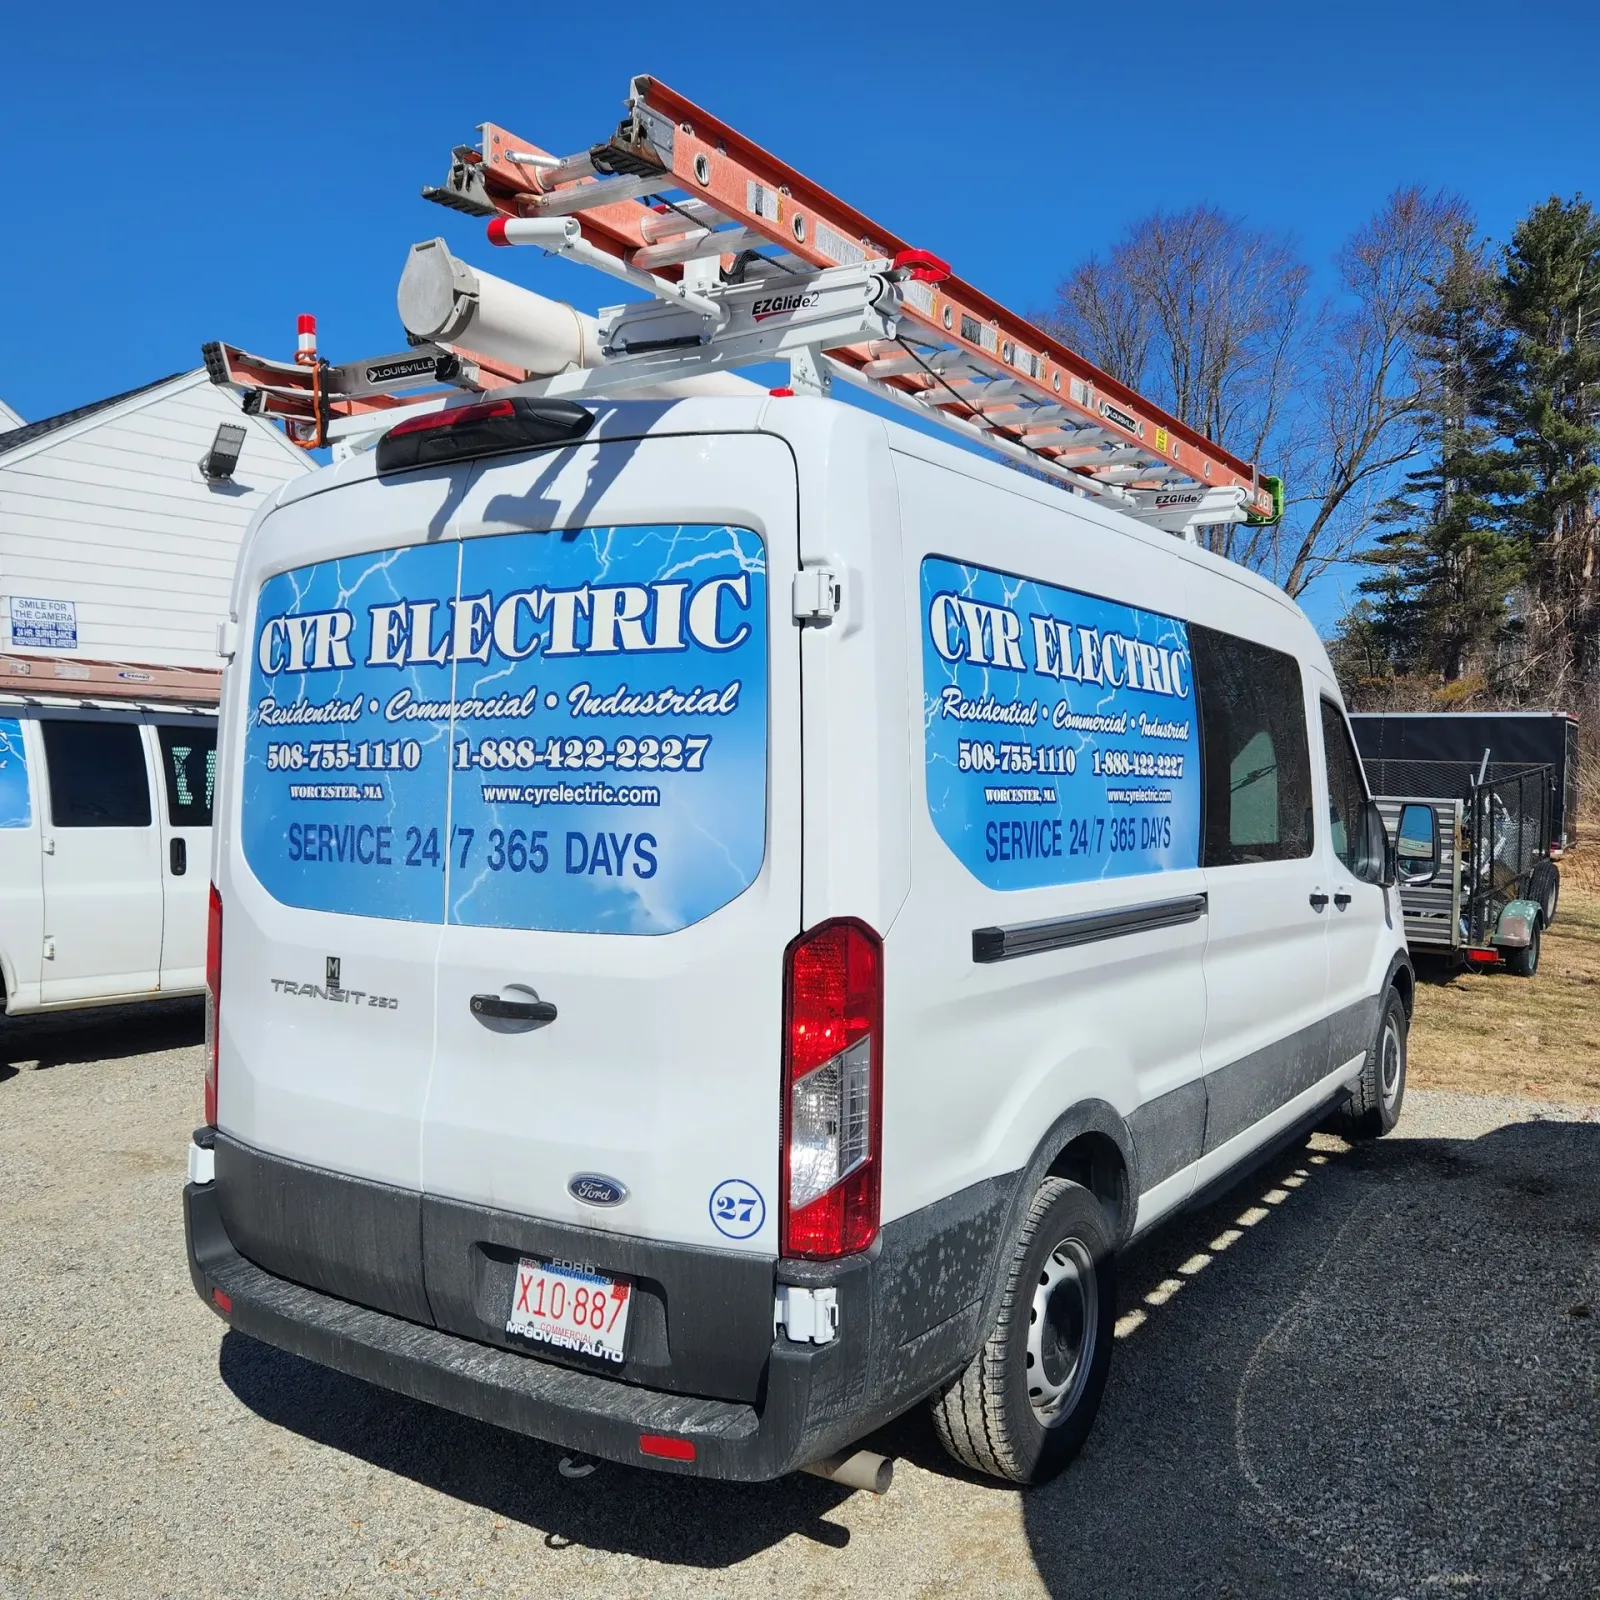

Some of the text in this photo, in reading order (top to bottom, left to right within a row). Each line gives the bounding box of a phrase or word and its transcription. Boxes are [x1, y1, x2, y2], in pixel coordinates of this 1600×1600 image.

[377, 360, 435, 378] LOUISVILLE
[1109, 410, 1137, 431] LOUISVILLE
[14, 609, 73, 622] THE CAMERA
[19, 599, 67, 612] SMILE FOR
[257, 573, 749, 676] CYR ELECTRIC
[929, 591, 1190, 699] CYR ELECTRIC
[257, 680, 741, 727] Residential Commercial Industrial
[941, 686, 1190, 741] Residential Commercial Industrial
[266, 736, 711, 771] 508-755-1110 1-888-422-2227
[958, 741, 1185, 778] 508-755-1110 1-888-422-2227
[289, 785, 383, 800] WORCESTER, MA
[482, 782, 660, 806] www.cyrelectric.com
[1042, 789, 1056, 803] MA
[1107, 787, 1172, 805] www.cyrelectric.com
[985, 815, 1171, 862] SERVICE 24/7 365 DAYS
[288, 822, 658, 879] SERVICE 24/7 365 DAYS
[271, 978, 366, 1005] TRANSIT
[368, 995, 399, 1010] 250
[578, 1179, 611, 1201] Ford
[716, 1196, 758, 1222] 27
[552, 1257, 596, 1276] FORD
[539, 1322, 592, 1343] COMMERCIAL
[580, 1340, 624, 1363] AUTO
